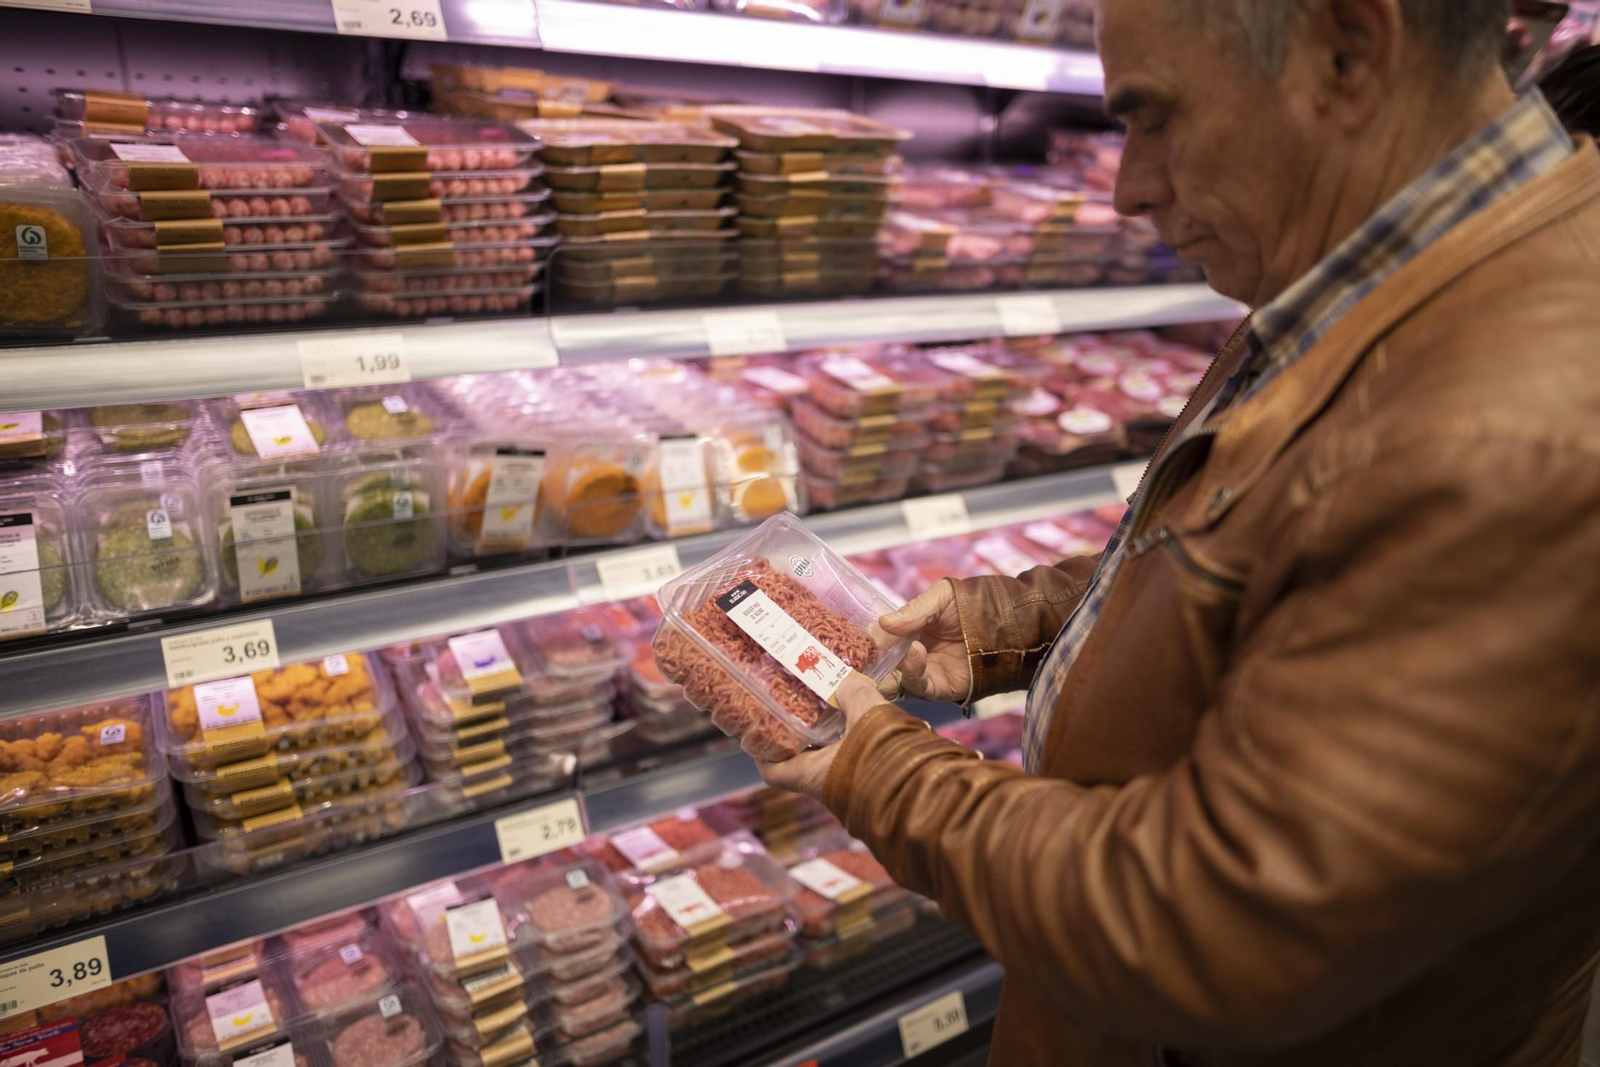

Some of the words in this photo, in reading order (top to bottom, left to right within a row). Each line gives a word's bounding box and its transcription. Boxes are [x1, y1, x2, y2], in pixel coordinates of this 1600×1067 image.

[389, 8, 437, 28] 2,69
[354, 351, 400, 373] 1,99
[793, 558, 810, 577] ESPAÑA
[223, 639, 270, 663] 3,69
[49, 957, 102, 988] 3,89
